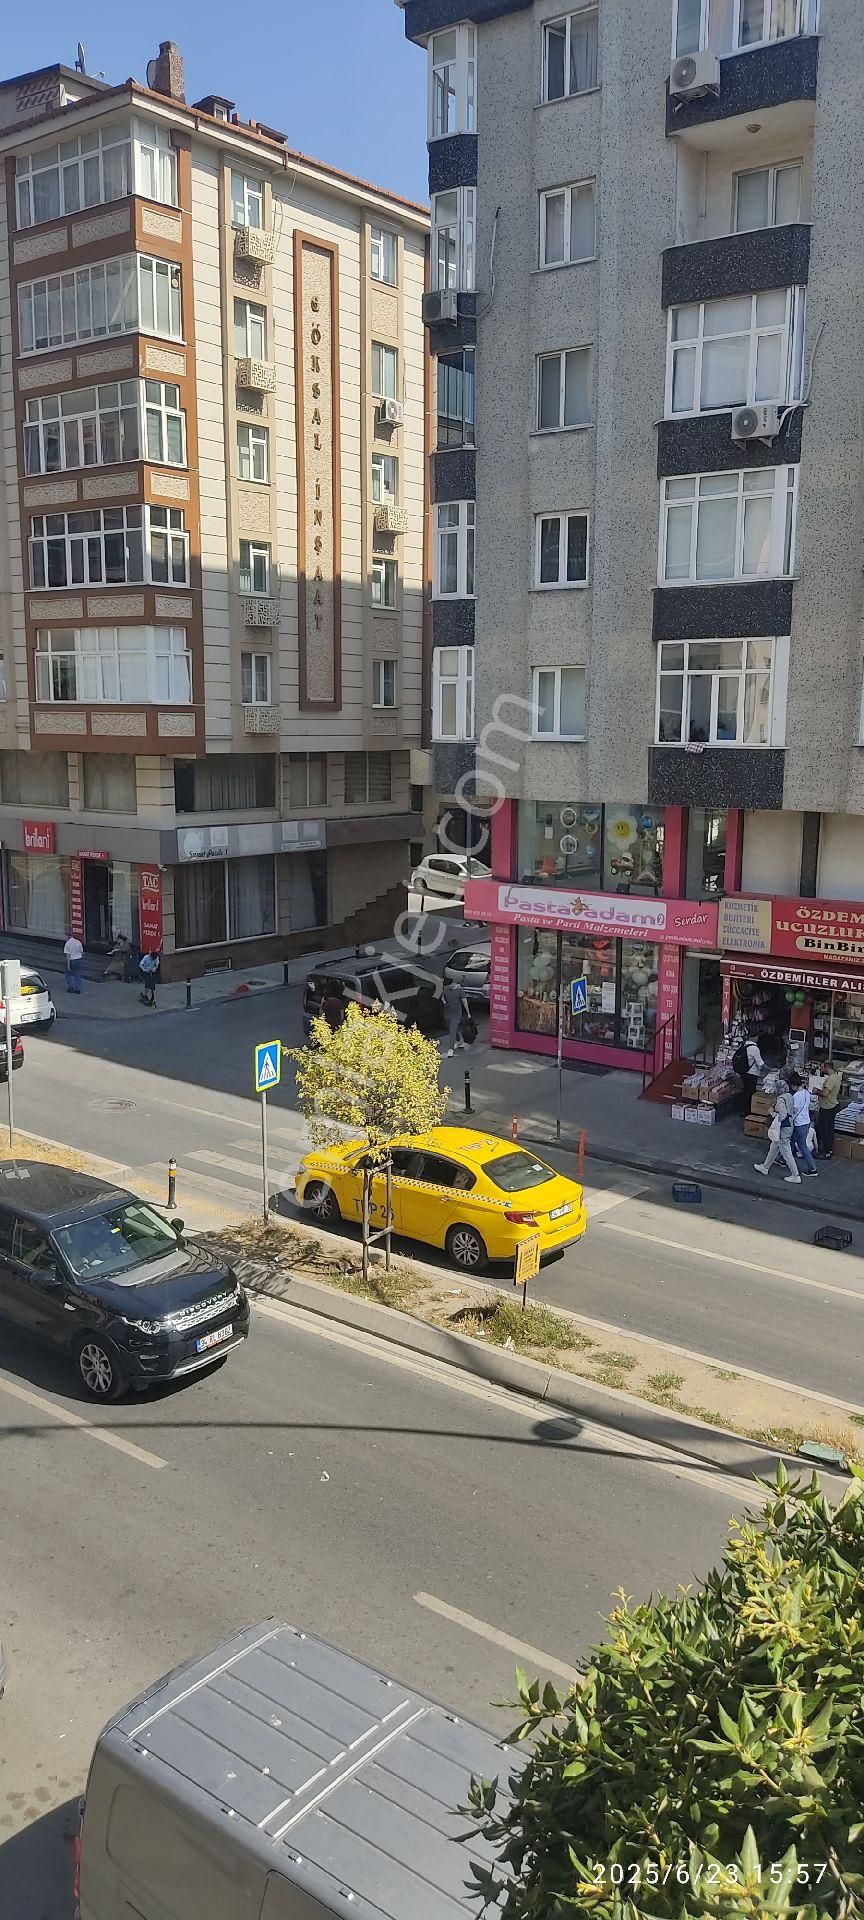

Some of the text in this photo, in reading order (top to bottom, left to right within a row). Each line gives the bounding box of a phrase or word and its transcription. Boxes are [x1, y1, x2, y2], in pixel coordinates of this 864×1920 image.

[724, 901, 759, 913] KOZMETİK
[513, 913, 540, 924] Pasta
[556, 919, 581, 929] Parti
[582, 921, 649, 937] Malzemeleri
[673, 913, 709, 927] Serdar
[760, 969, 838, 988] ÖZDEMİRLER
